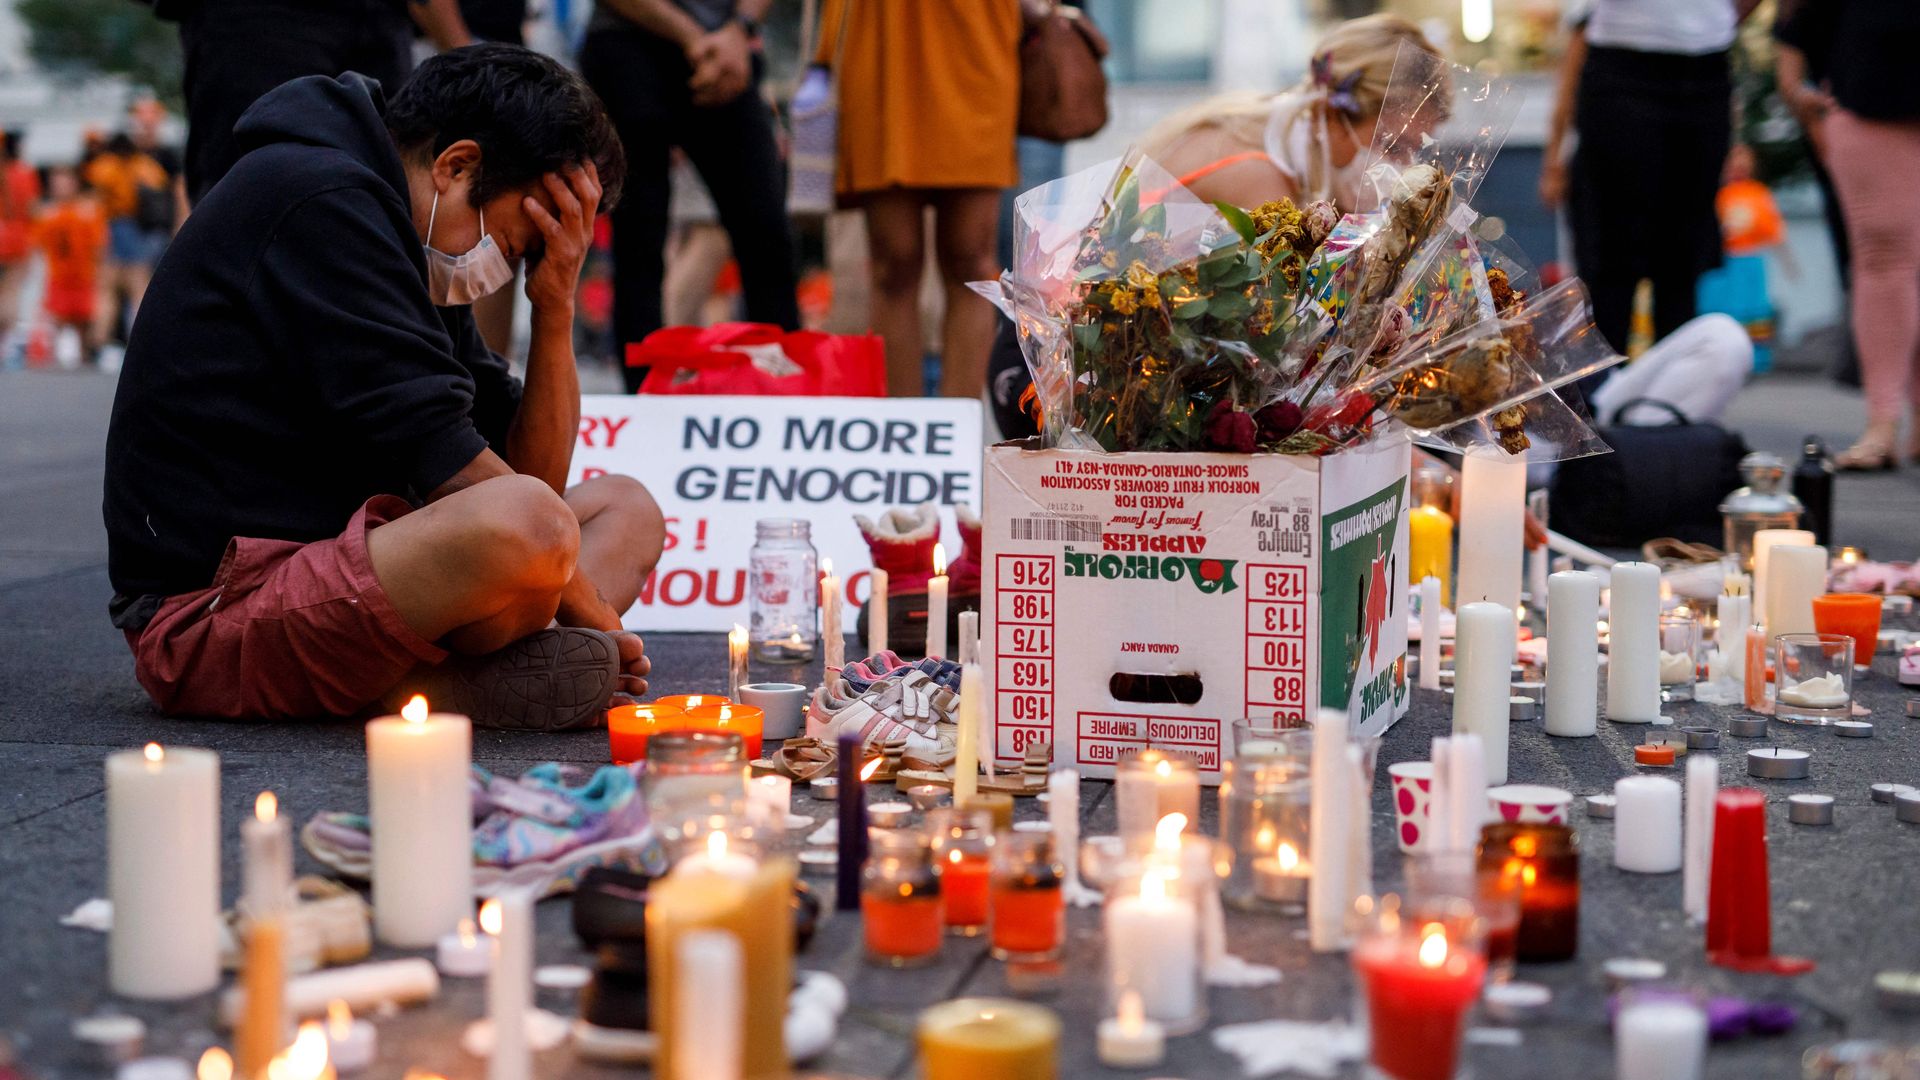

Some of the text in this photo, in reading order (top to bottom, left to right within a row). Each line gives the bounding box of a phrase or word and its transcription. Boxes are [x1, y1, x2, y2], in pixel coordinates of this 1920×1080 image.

[683, 417, 954, 455] NO MORE
[1055, 460, 1074, 474] 4L1
[675, 466, 971, 505] GENOCIDE
[1040, 476, 1260, 494] NORFOLK FRUIT GROWERS ASSOCIATION
[1114, 494, 1184, 509] PACKED FOR
[1147, 510, 1166, 530] for
[1251, 510, 1309, 532] 88 Tray
[1102, 532, 1206, 554] APPLES
[1258, 528, 1312, 558] Empire
[1013, 560, 1050, 586] 216
[1264, 572, 1302, 598] 125
[1013, 594, 1050, 619] 198
[1264, 606, 1302, 632] 113
[1013, 628, 1050, 653] 175
[1120, 642, 1180, 654] CANADA FANCY
[1264, 642, 1302, 667] 100
[1013, 662, 1050, 686] 163
[1273, 676, 1301, 702] 88
[1012, 696, 1049, 720] 150
[1091, 720, 1136, 736] EMPIRE
[1150, 724, 1215, 740] DELICIOUS
[1090, 744, 1114, 760] RED
